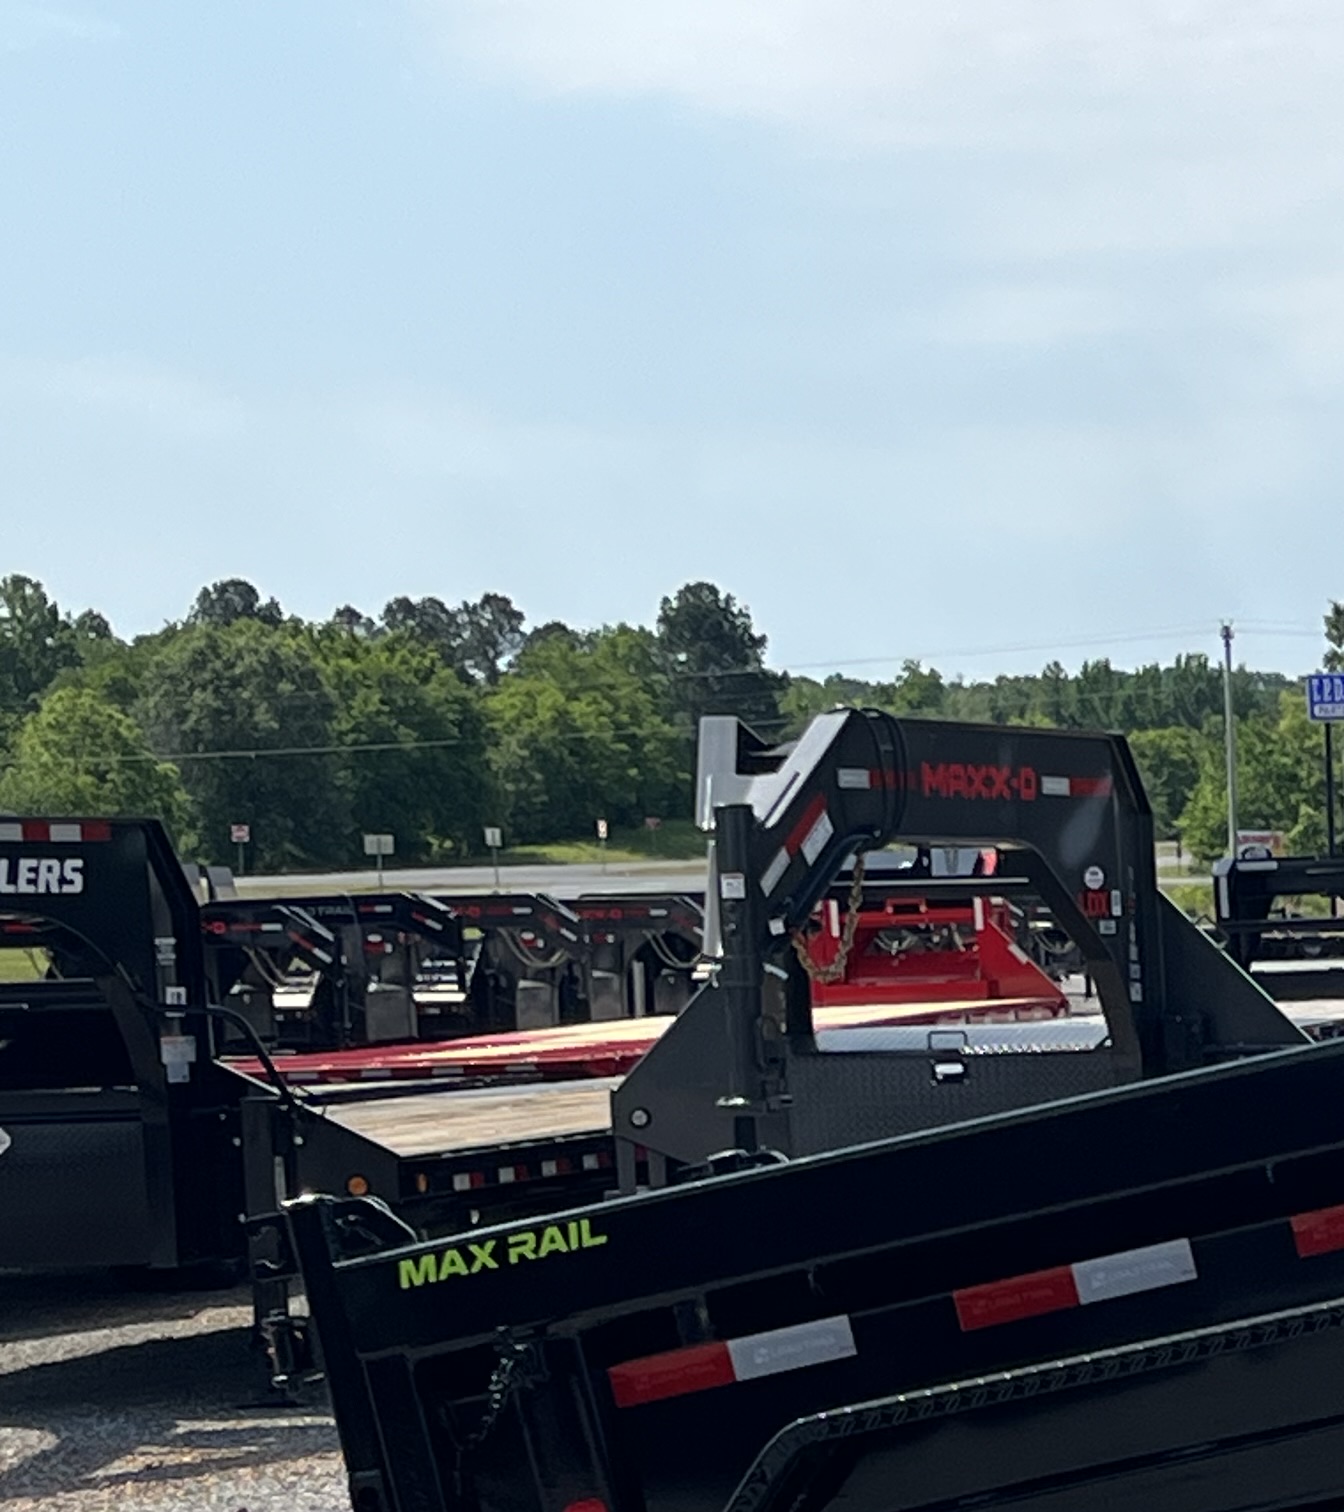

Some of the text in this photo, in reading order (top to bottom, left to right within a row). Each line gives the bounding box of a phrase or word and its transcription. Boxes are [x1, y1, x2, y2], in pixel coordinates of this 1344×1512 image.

[921, 761, 1037, 801] MAXX-D
[398, 1218, 608, 1289] MAX RAIL
